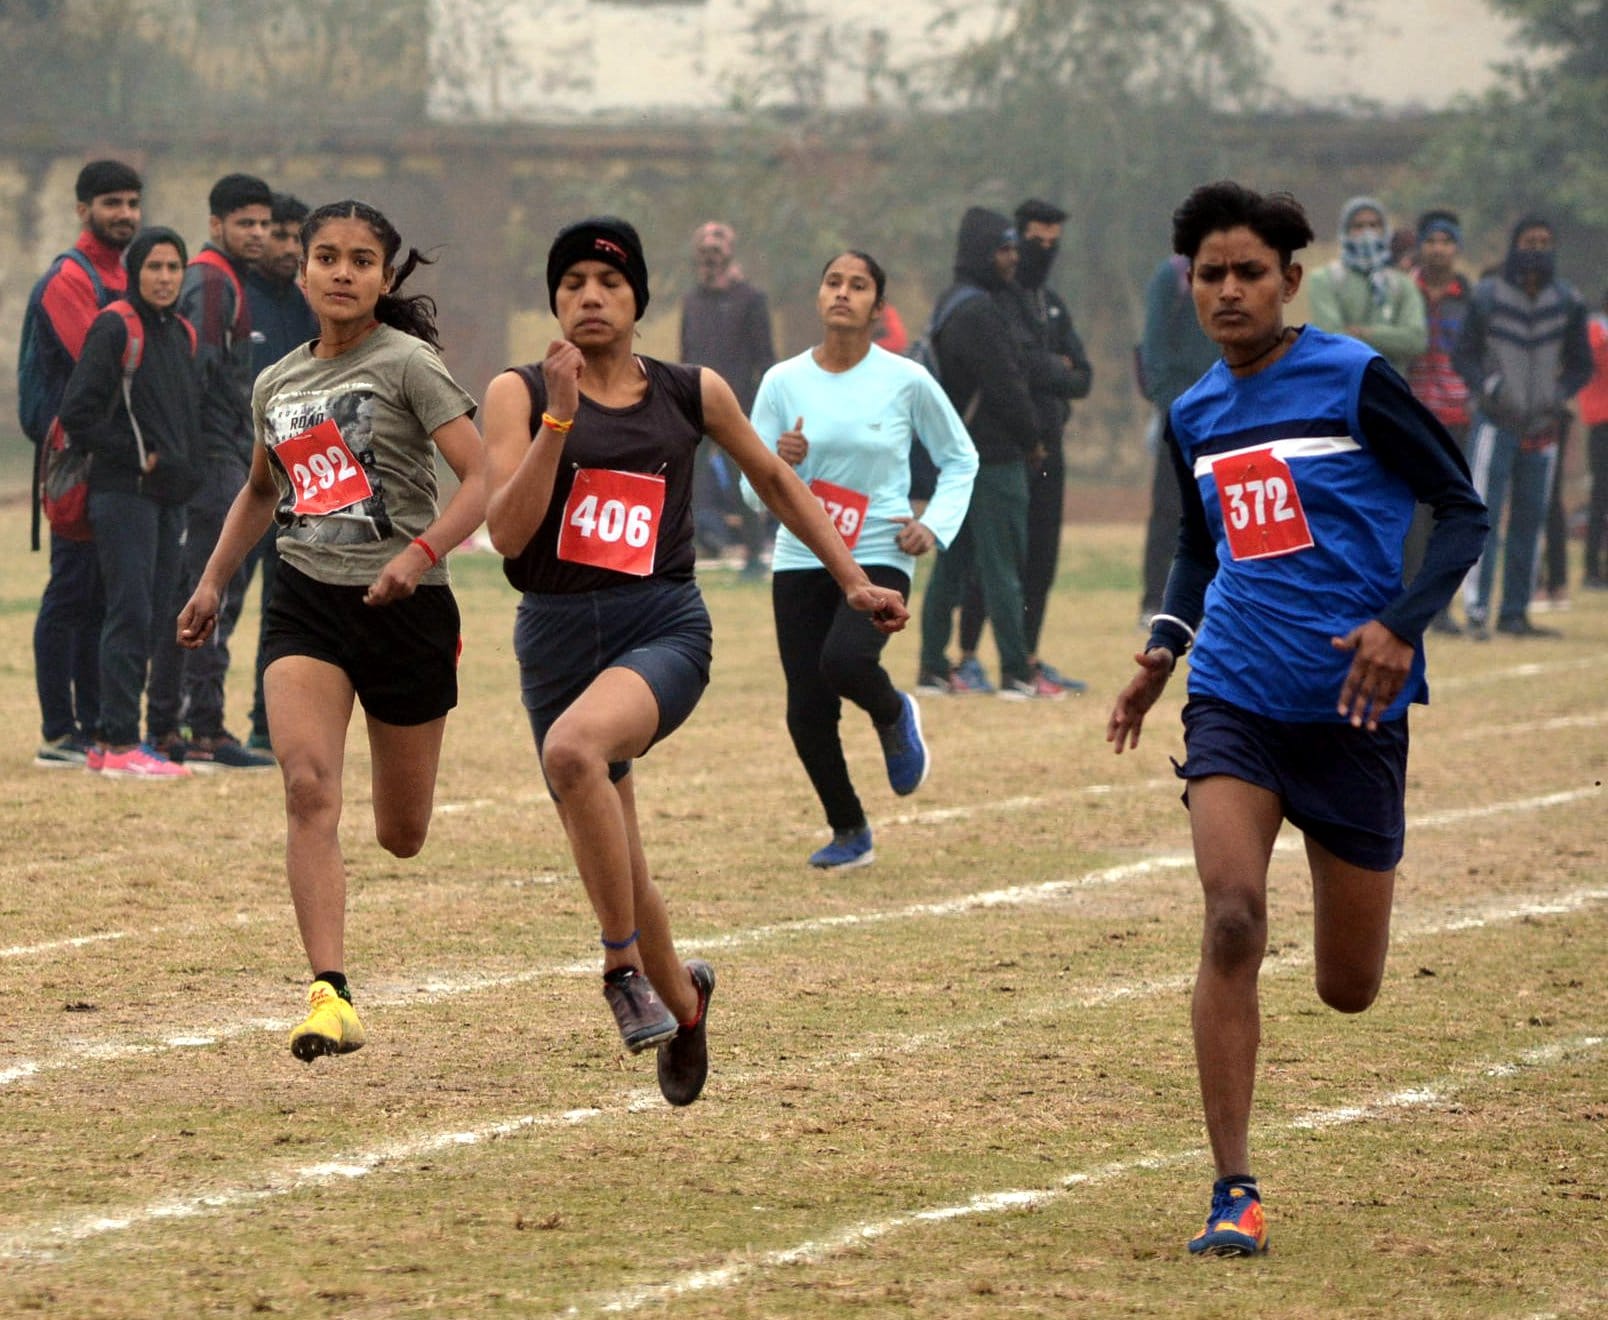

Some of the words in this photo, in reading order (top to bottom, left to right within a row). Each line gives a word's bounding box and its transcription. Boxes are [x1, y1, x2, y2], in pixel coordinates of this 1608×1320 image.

[290, 413, 324, 430] ROAD
[293, 446, 357, 500] 292
[570, 495, 652, 548] 406
[815, 497, 860, 537] 79
[1224, 477, 1296, 530] 372
